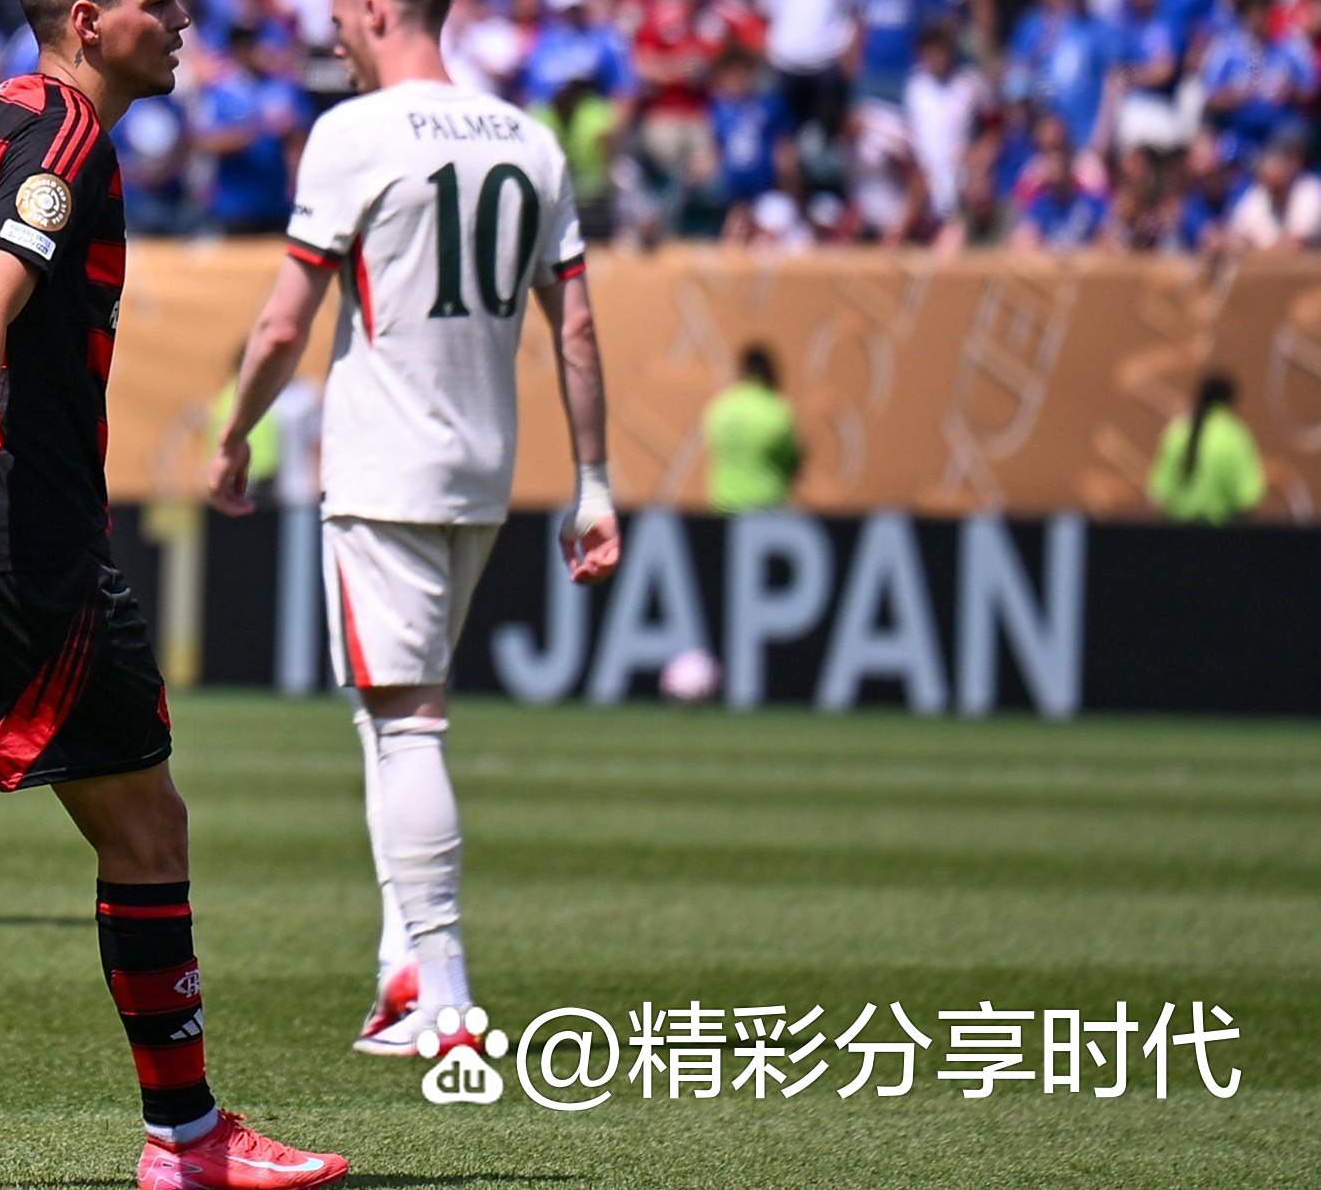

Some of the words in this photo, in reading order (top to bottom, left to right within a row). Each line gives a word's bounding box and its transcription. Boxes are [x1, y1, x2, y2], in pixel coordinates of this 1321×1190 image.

[408, 111, 526, 143] PALMER
[427, 162, 540, 318] 10
[490, 507, 1087, 721] JAPAN
